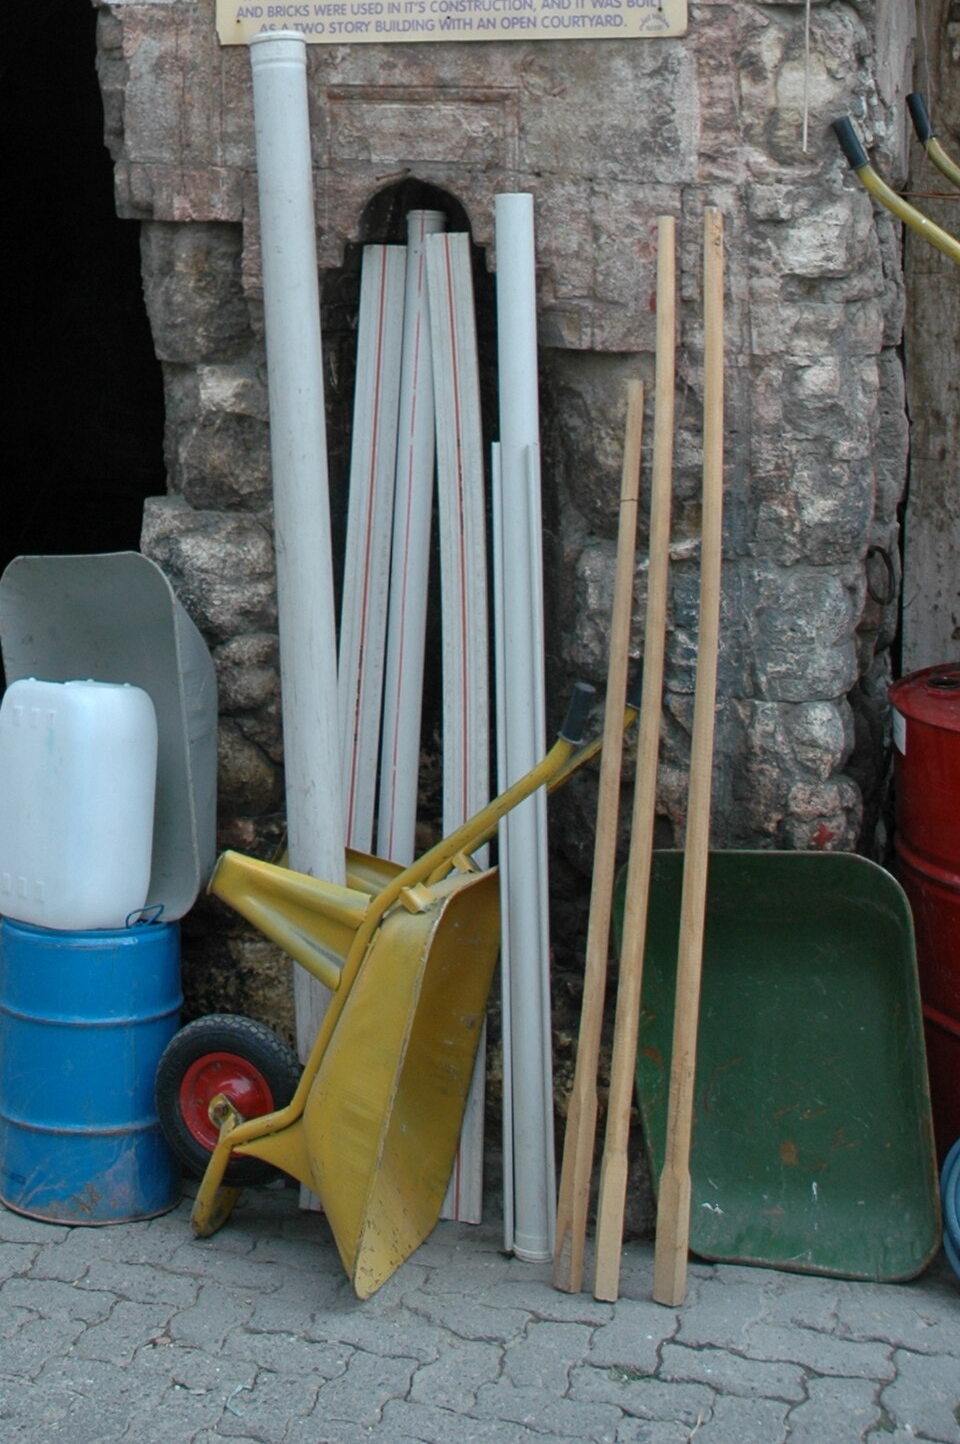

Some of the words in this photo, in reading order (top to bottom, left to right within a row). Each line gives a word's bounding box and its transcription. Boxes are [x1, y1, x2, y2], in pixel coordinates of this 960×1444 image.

[236, 6, 263, 18] AND
[267, 4, 310, 17] BRICKS
[314, 3, 347, 16] WERE
[350, 2, 383, 15] USED
[388, 1, 400, 14] IN
[404, 0, 425, 13] IT'S
[259, 23, 275, 32] AS
[293, 22, 325, 34] TWO
[329, 21, 371, 33] STORY
[375, 19, 435, 32] BUILDING
[439, 17, 472, 30] WITH
[477, 16, 497, 28] AN
[500, 15, 537, 28] OPEN
[541, 14, 627, 28] COURTYARD.
